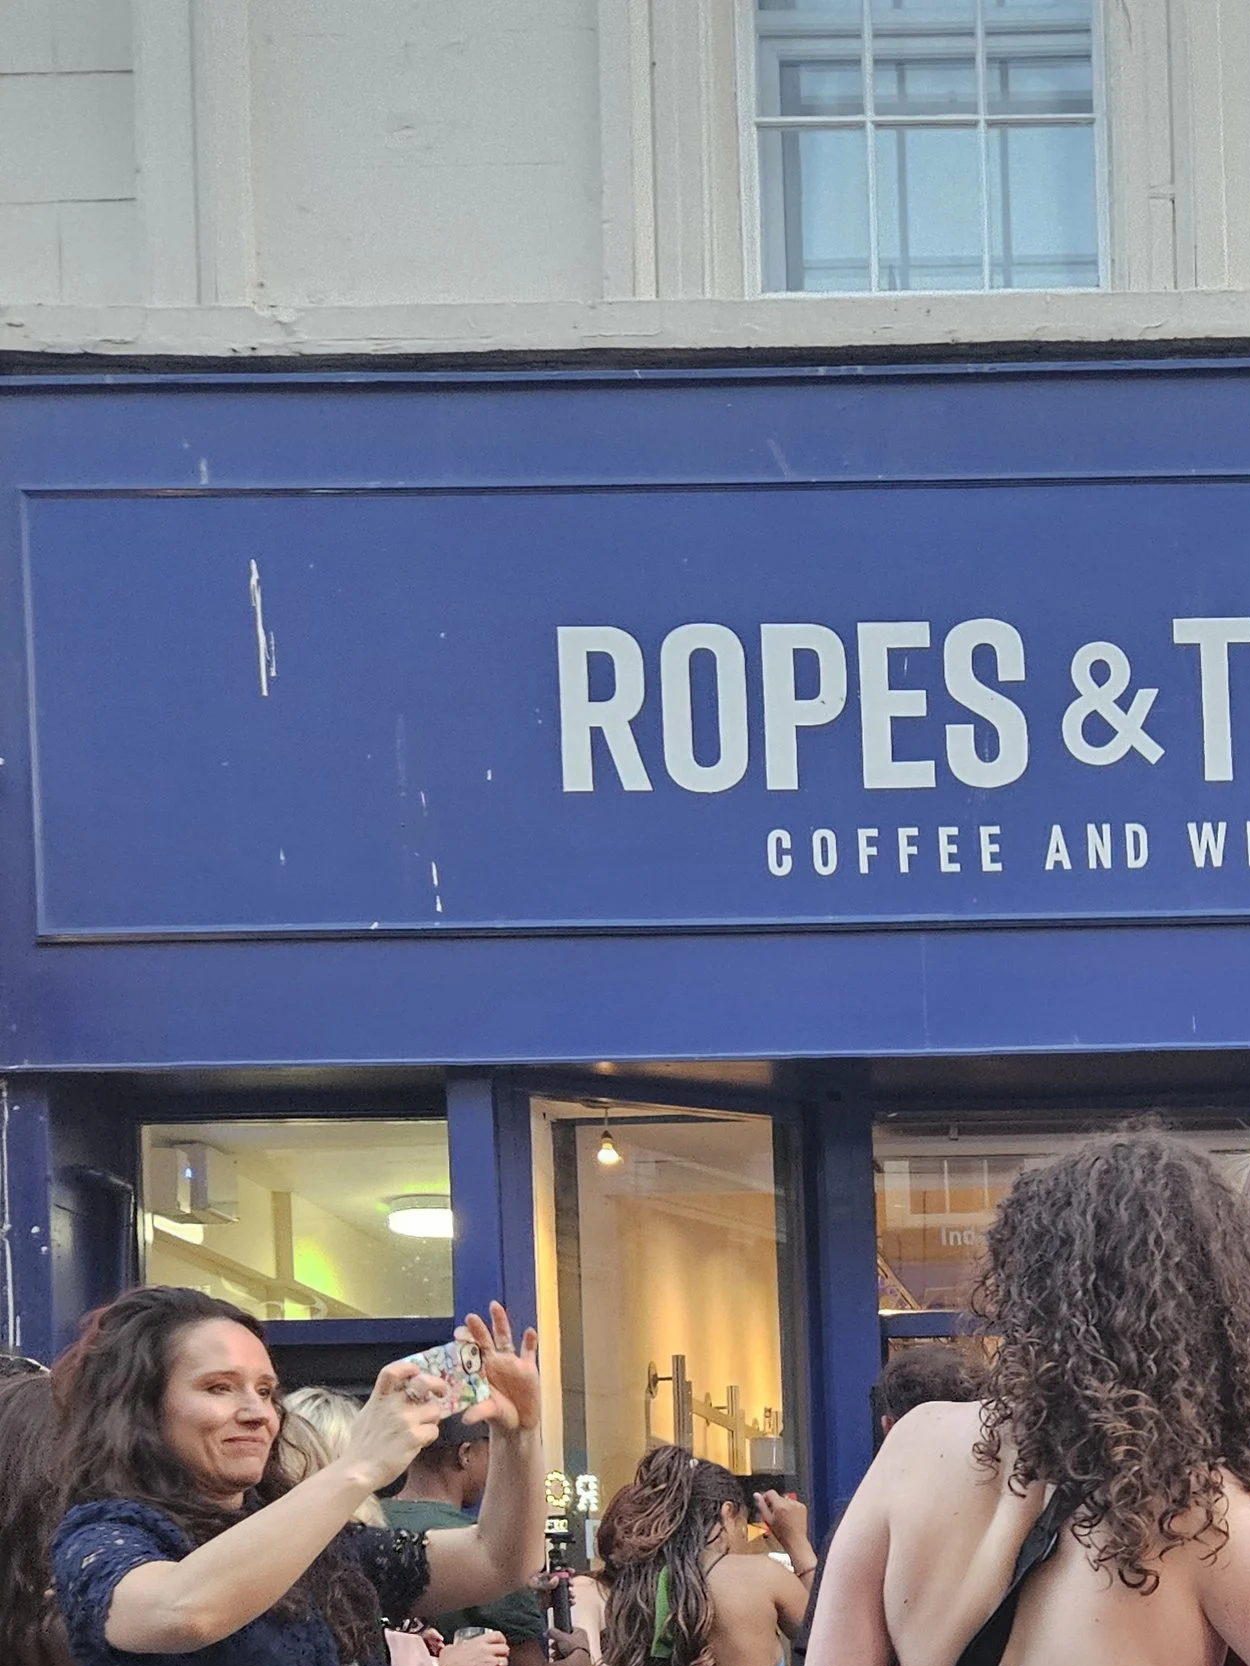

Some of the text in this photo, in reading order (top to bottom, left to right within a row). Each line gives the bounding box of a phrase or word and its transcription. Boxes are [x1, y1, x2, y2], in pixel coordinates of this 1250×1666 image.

[557, 618, 1028, 793] ROPES
[1062, 641, 1166, 766] &
[767, 826, 1003, 877] COFFEE
[1045, 823, 1149, 871] AND
